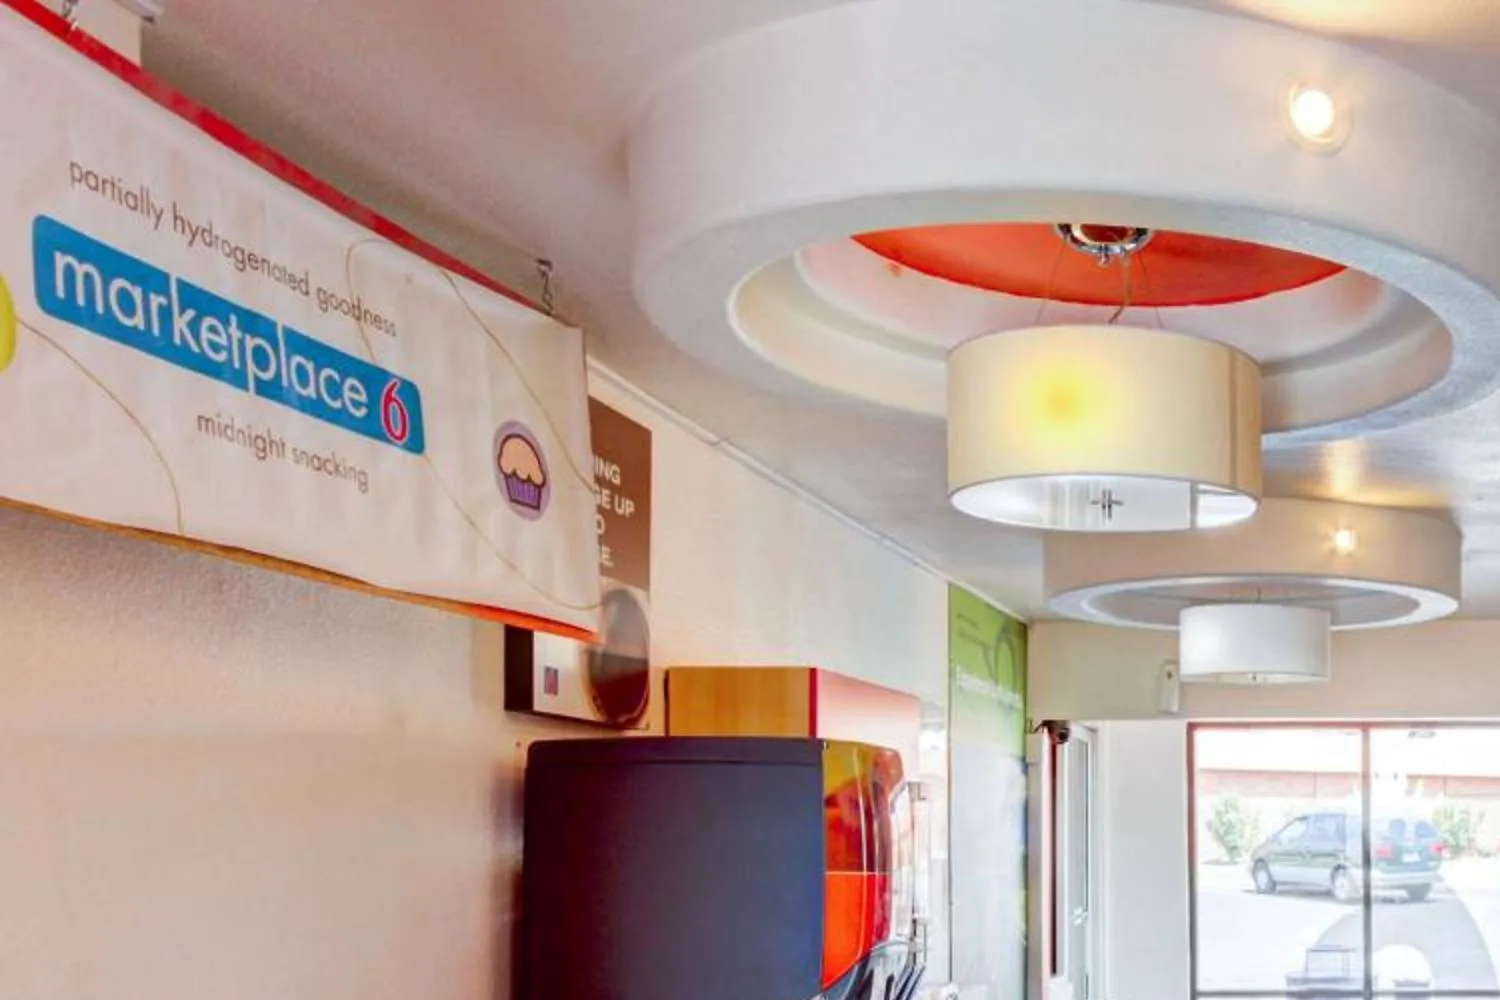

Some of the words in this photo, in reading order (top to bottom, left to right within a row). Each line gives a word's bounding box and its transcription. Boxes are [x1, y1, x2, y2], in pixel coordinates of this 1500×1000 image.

[69, 160, 165, 232] partially
[172, 200, 311, 297] hydrogenated
[316, 286, 398, 338] goodness
[53, 249, 371, 419] marketplace
[378, 378, 410, 446] 6
[197, 414, 287, 461] midnight
[292, 447, 370, 494] snacking
[614, 493, 636, 518] UP
